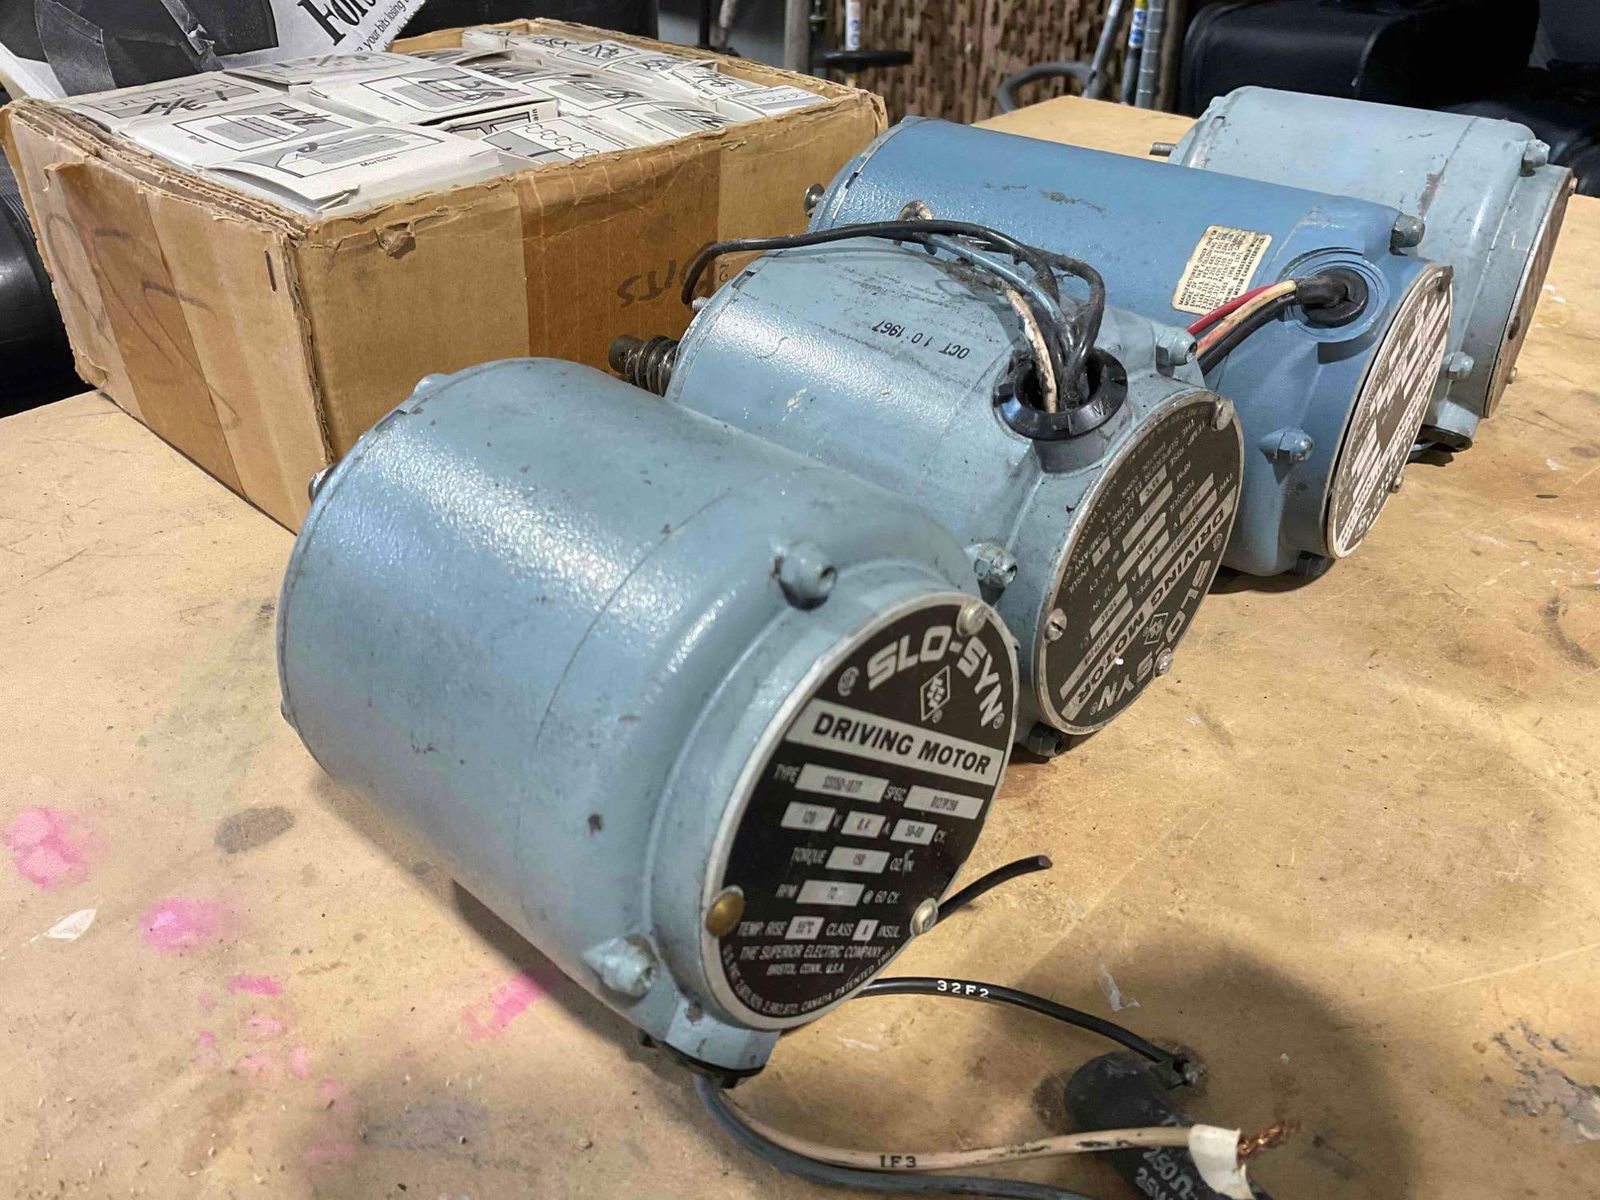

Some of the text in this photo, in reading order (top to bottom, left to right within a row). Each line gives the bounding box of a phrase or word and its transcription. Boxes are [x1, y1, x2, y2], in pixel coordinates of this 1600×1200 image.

[871, 320, 906, 338] 1967
[939, 342, 970, 360] OCT
[1108, 480, 1142, 524] ELECTRIC
[1149, 506, 1225, 608] DRIVING
[1075, 610, 1146, 705] MOTOR
[813, 711, 991, 775] DRIVING MOTOR
[773, 764, 800, 784] TYPE
[792, 847, 828, 865] TORQUE
[875, 890, 887, 903] 60
[826, 922, 854, 936] CLASS
[804, 945, 844, 959] ELECTRIC
[845, 946, 882, 960] COMPANY
[937, 980, 989, 999] 32F2
